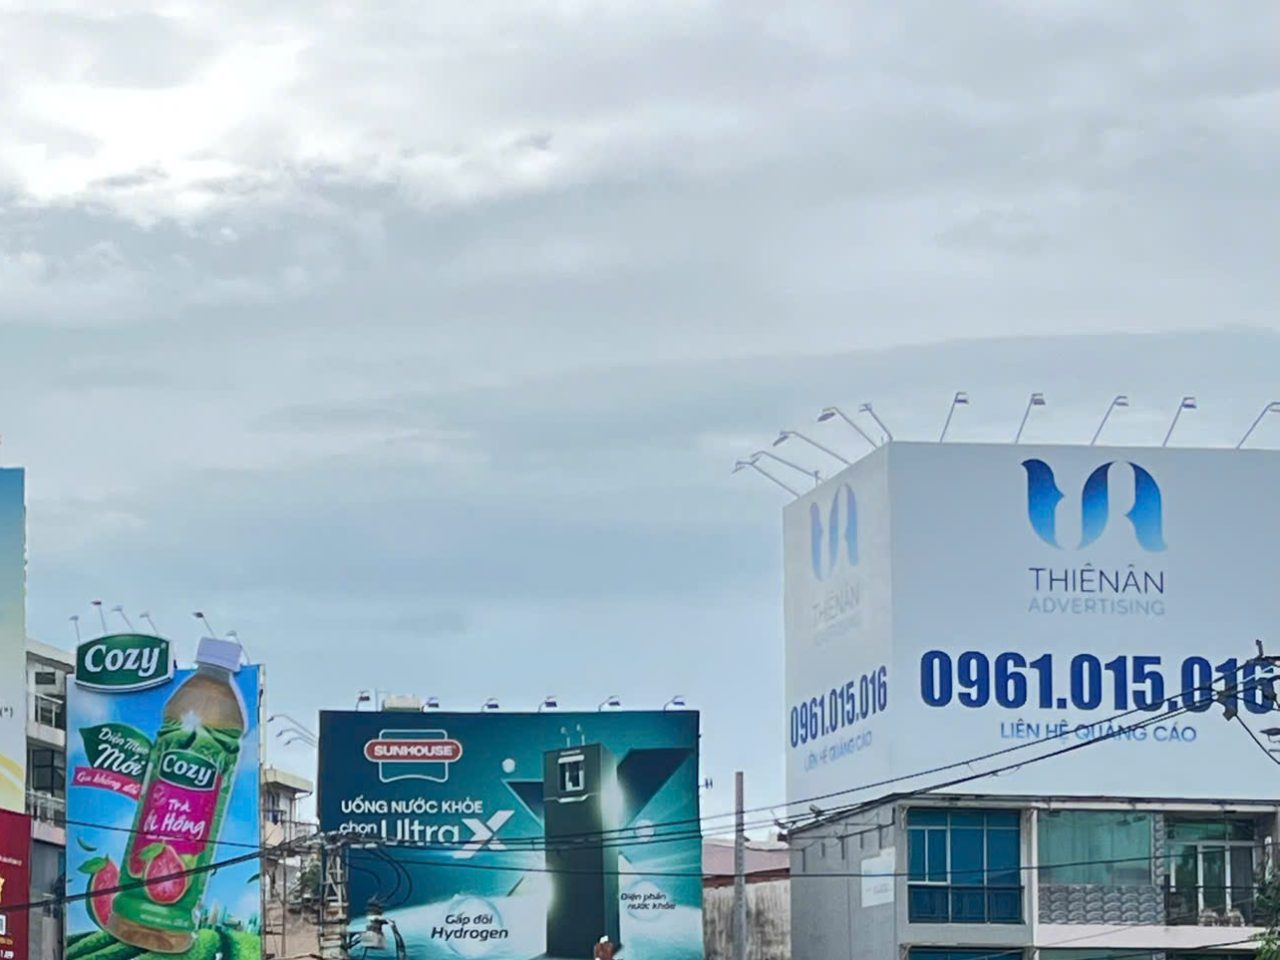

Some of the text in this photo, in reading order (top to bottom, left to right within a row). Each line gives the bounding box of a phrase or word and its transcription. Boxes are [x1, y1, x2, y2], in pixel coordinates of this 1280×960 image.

[1028, 597, 1166, 617] ADVERTISING
[84, 644, 160, 677] Cozy
[920, 650, 1275, 715] 0961.015.016
[790, 665, 888, 749] 0961.015.016
[1000, 718, 1197, 746] LIÊN HỆ QUẢNG CÁO
[93, 743, 146, 776] Mới
[373, 745, 453, 757] SUNHOUSE
[162, 754, 213, 786] Cozy
[341, 795, 483, 814] UỐNG NƯỚC KHỎE
[445, 912, 470, 926] Gấp
[431, 926, 508, 942] Hydrogen
